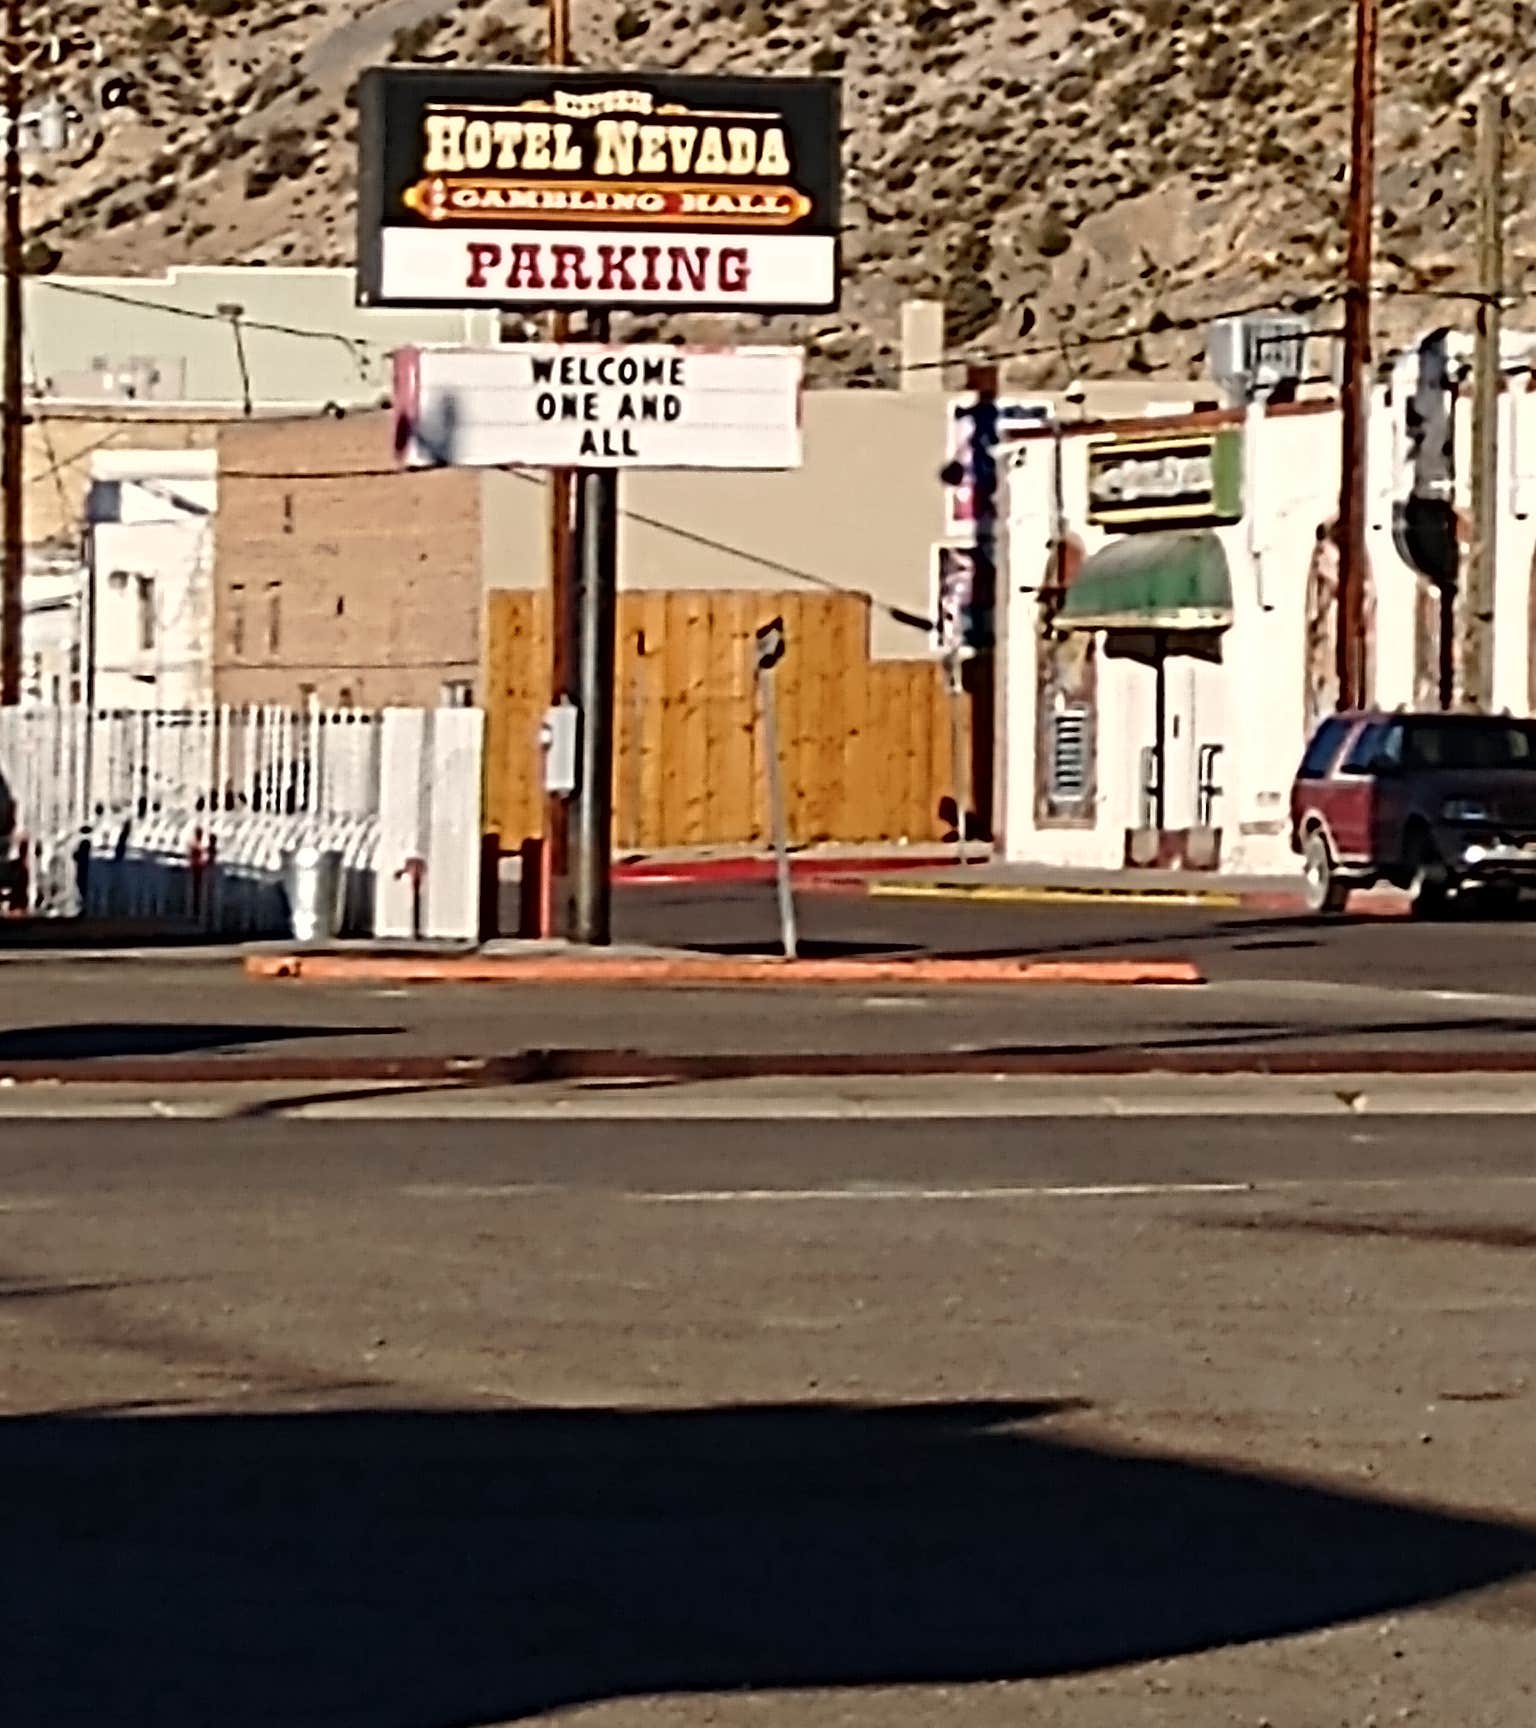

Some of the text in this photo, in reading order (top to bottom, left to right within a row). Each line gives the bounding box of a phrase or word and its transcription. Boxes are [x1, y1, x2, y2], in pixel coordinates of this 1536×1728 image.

[424, 116, 790, 175] HOTEL NEVADA
[451, 189, 790, 214] GAMBLING HALL
[466, 242, 751, 292] PARKING
[531, 357, 686, 386] WELCOME
[536, 392, 682, 422] ONE AND
[579, 429, 639, 457] ALL
